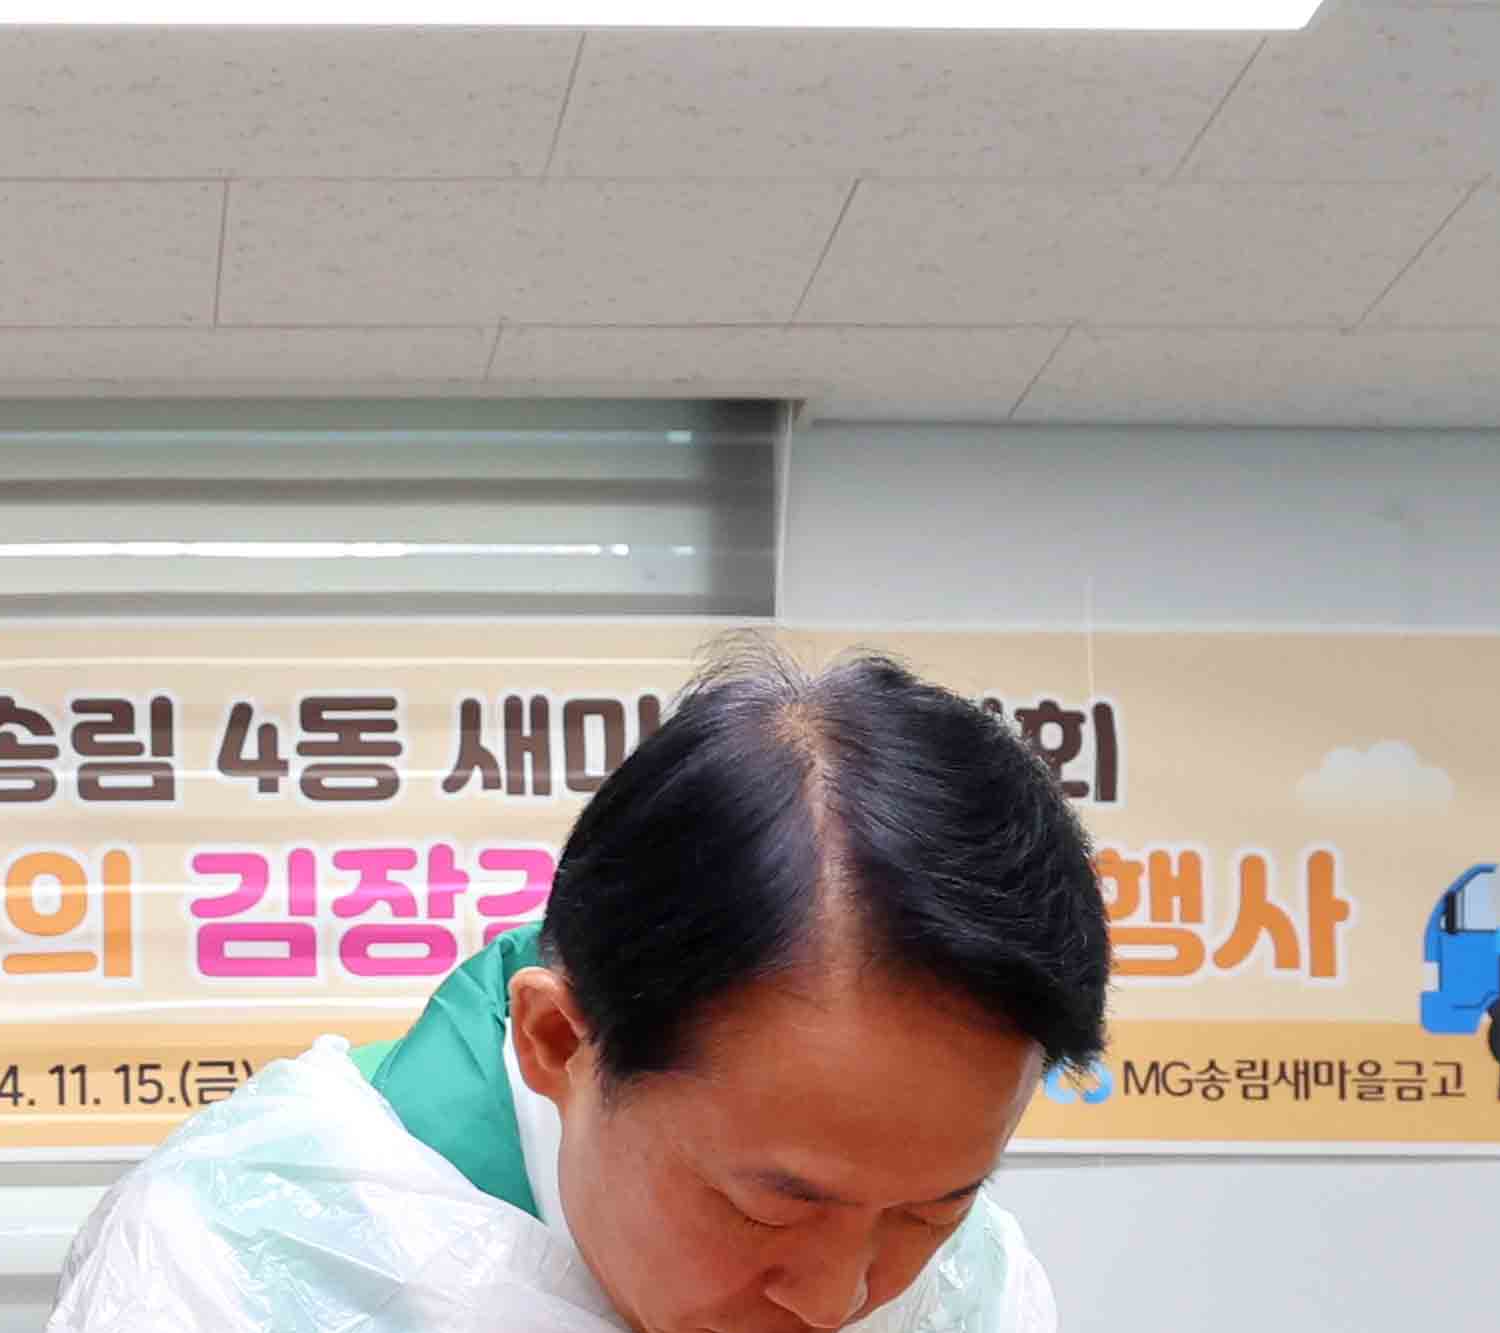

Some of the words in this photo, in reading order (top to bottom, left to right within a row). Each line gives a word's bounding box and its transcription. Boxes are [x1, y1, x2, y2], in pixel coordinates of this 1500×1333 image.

[217, 696, 403, 802] 4동
[47, 1062, 101, 1106] 11.
[1122, 1059, 1468, 1102] MG송림새마을금고
